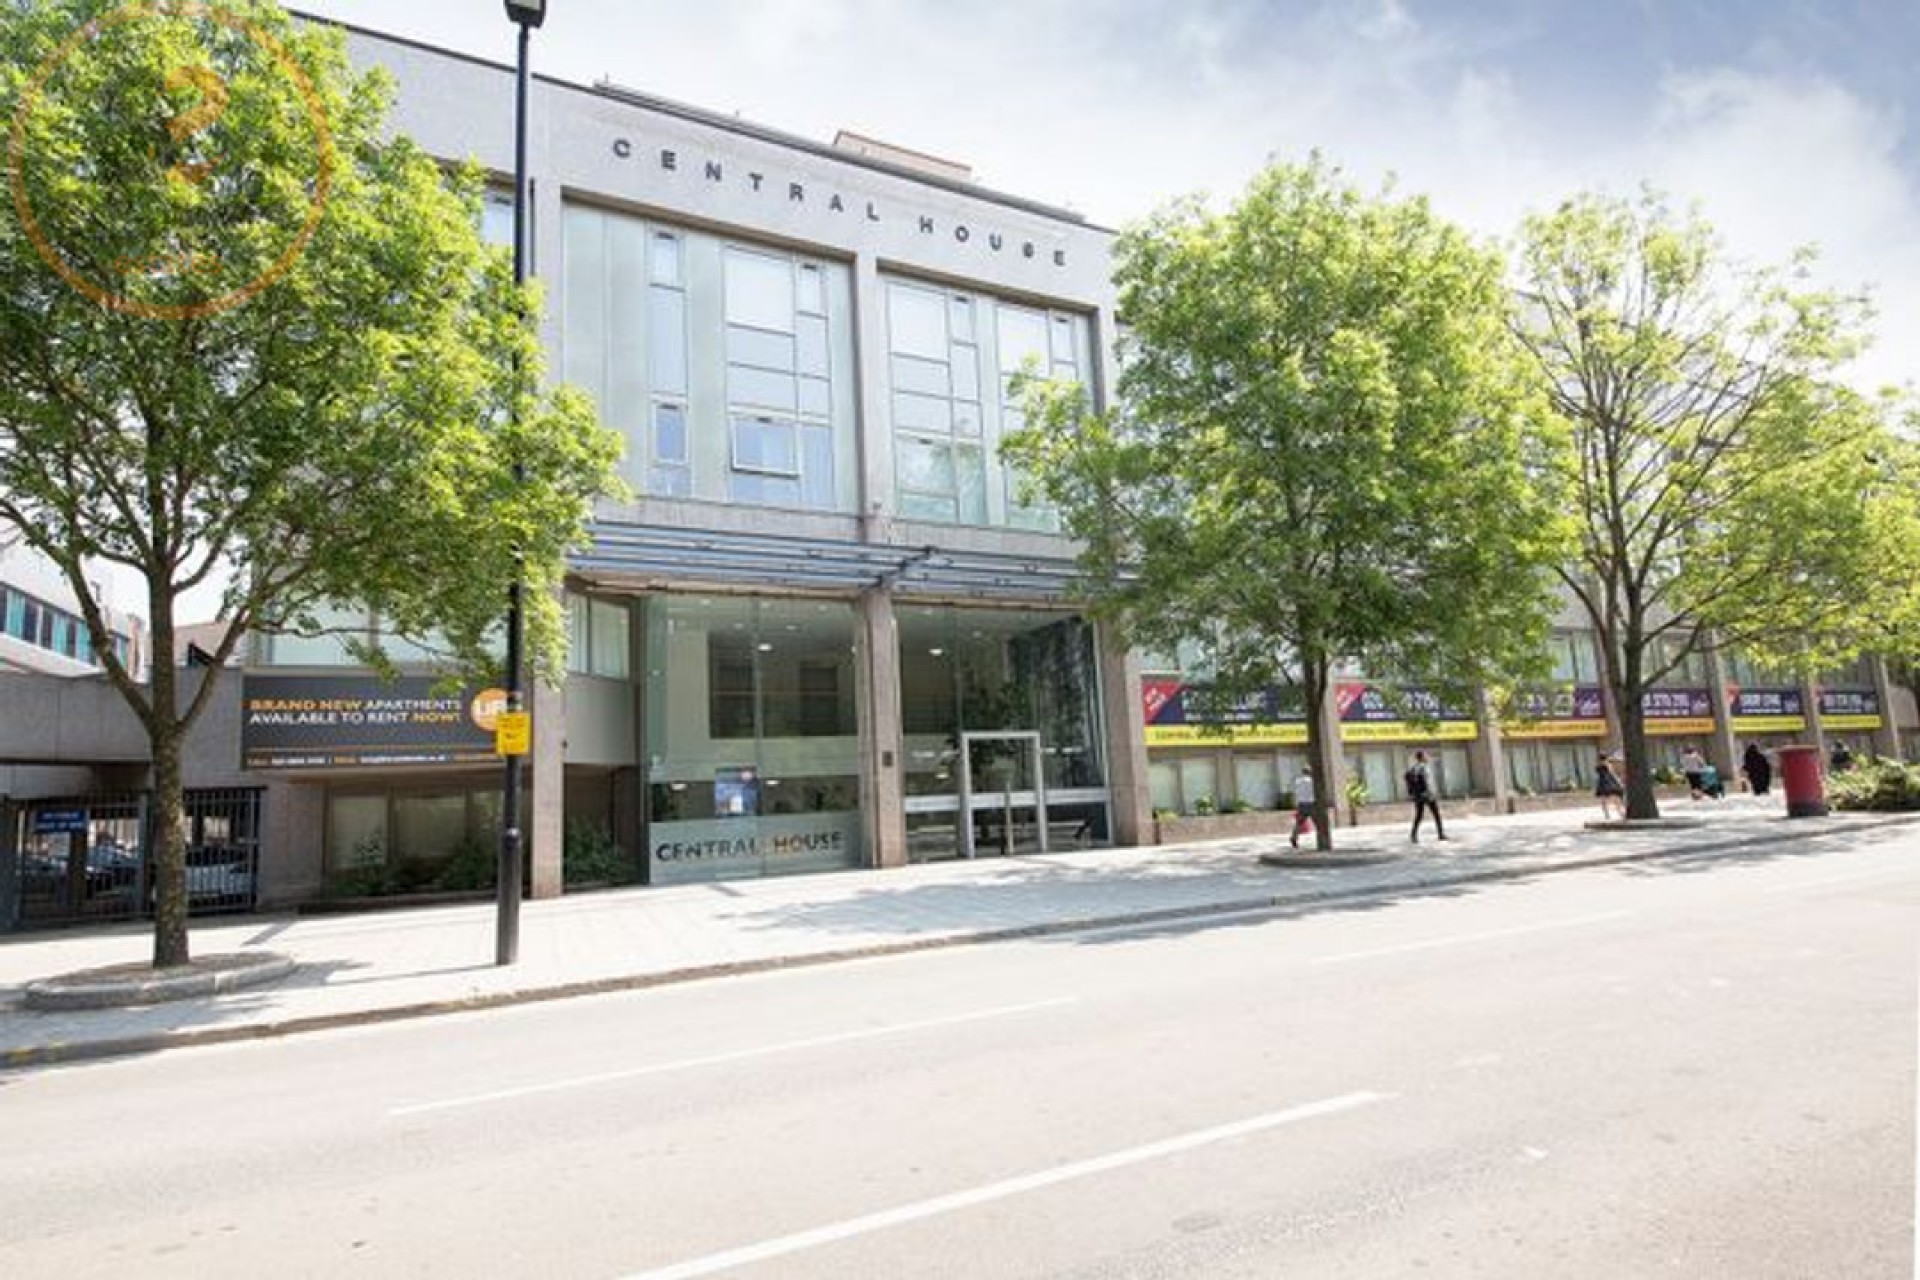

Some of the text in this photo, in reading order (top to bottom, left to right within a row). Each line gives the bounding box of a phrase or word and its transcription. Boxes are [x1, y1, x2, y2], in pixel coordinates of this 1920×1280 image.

[611, 137, 1068, 267] CENTRAL HOUSE
[249, 699, 317, 711] BRAND
[319, 699, 361, 711] NEW
[250, 712, 336, 724] AVAILABLE
[341, 712, 364, 724] TO
[367, 712, 409, 723] RENT
[656, 830, 842, 862] CENTRAL HOUSE
